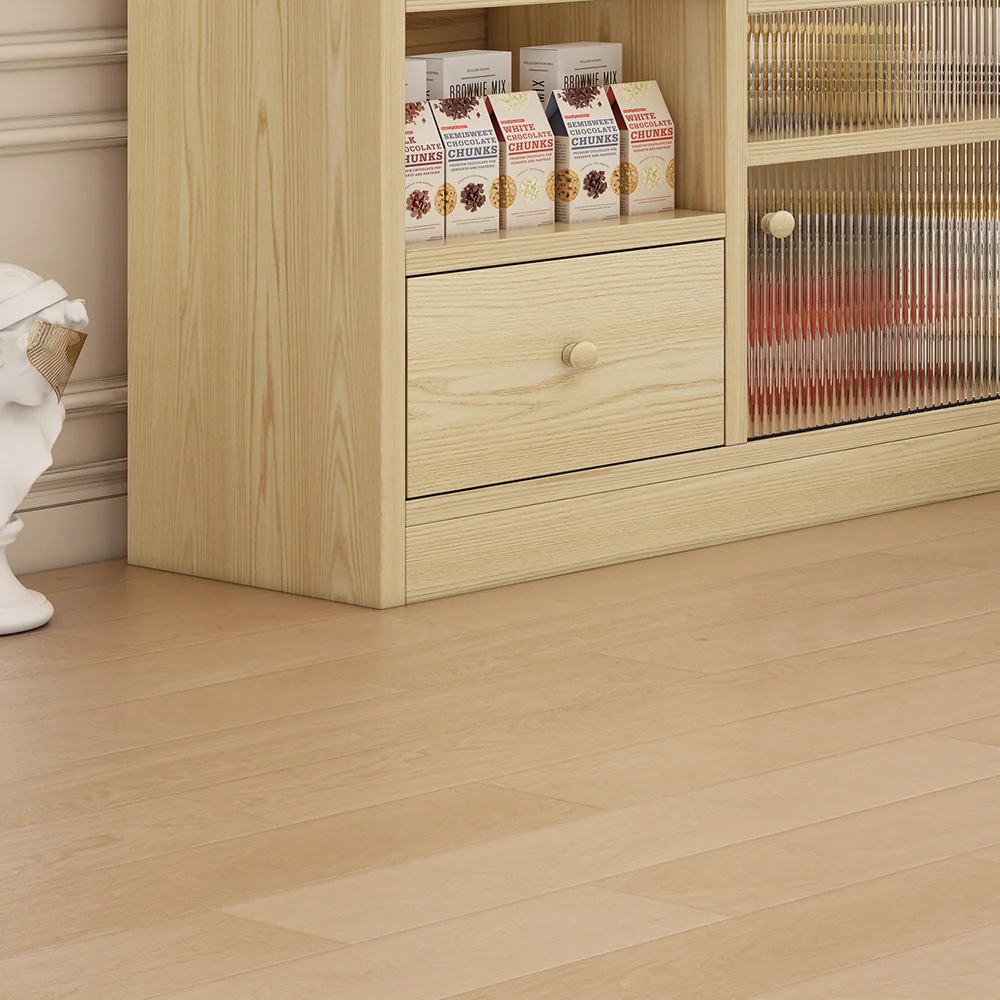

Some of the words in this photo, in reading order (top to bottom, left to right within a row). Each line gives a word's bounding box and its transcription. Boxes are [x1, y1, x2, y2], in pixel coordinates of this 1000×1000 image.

[564, 72, 600, 89] BROWNIE
[604, 70, 618, 86] MIX
[450, 81, 487, 99] BROWNIE
[491, 80, 506, 95] MIX
[626, 112, 656, 122] WHITE
[567, 118, 614, 128] SEMISWEET
[629, 120, 672, 130] CHOCOLATE
[503, 124, 536, 133] WHITE
[570, 126, 618, 136] CHOCOLATE
[444, 130, 492, 140] SEMISWEET
[506, 131, 552, 141] CHOCOLATE
[631, 128, 674, 140] CHUNKS
[446, 137, 496, 148] CHOCOLATE
[572, 134, 618, 146] CHUNKS
[405, 143, 442, 153] OCOLATE
[508, 139, 554, 152] CHUNKS
[448, 146, 498, 158] CHUNKS
[405, 152, 443, 163] HUNKS
